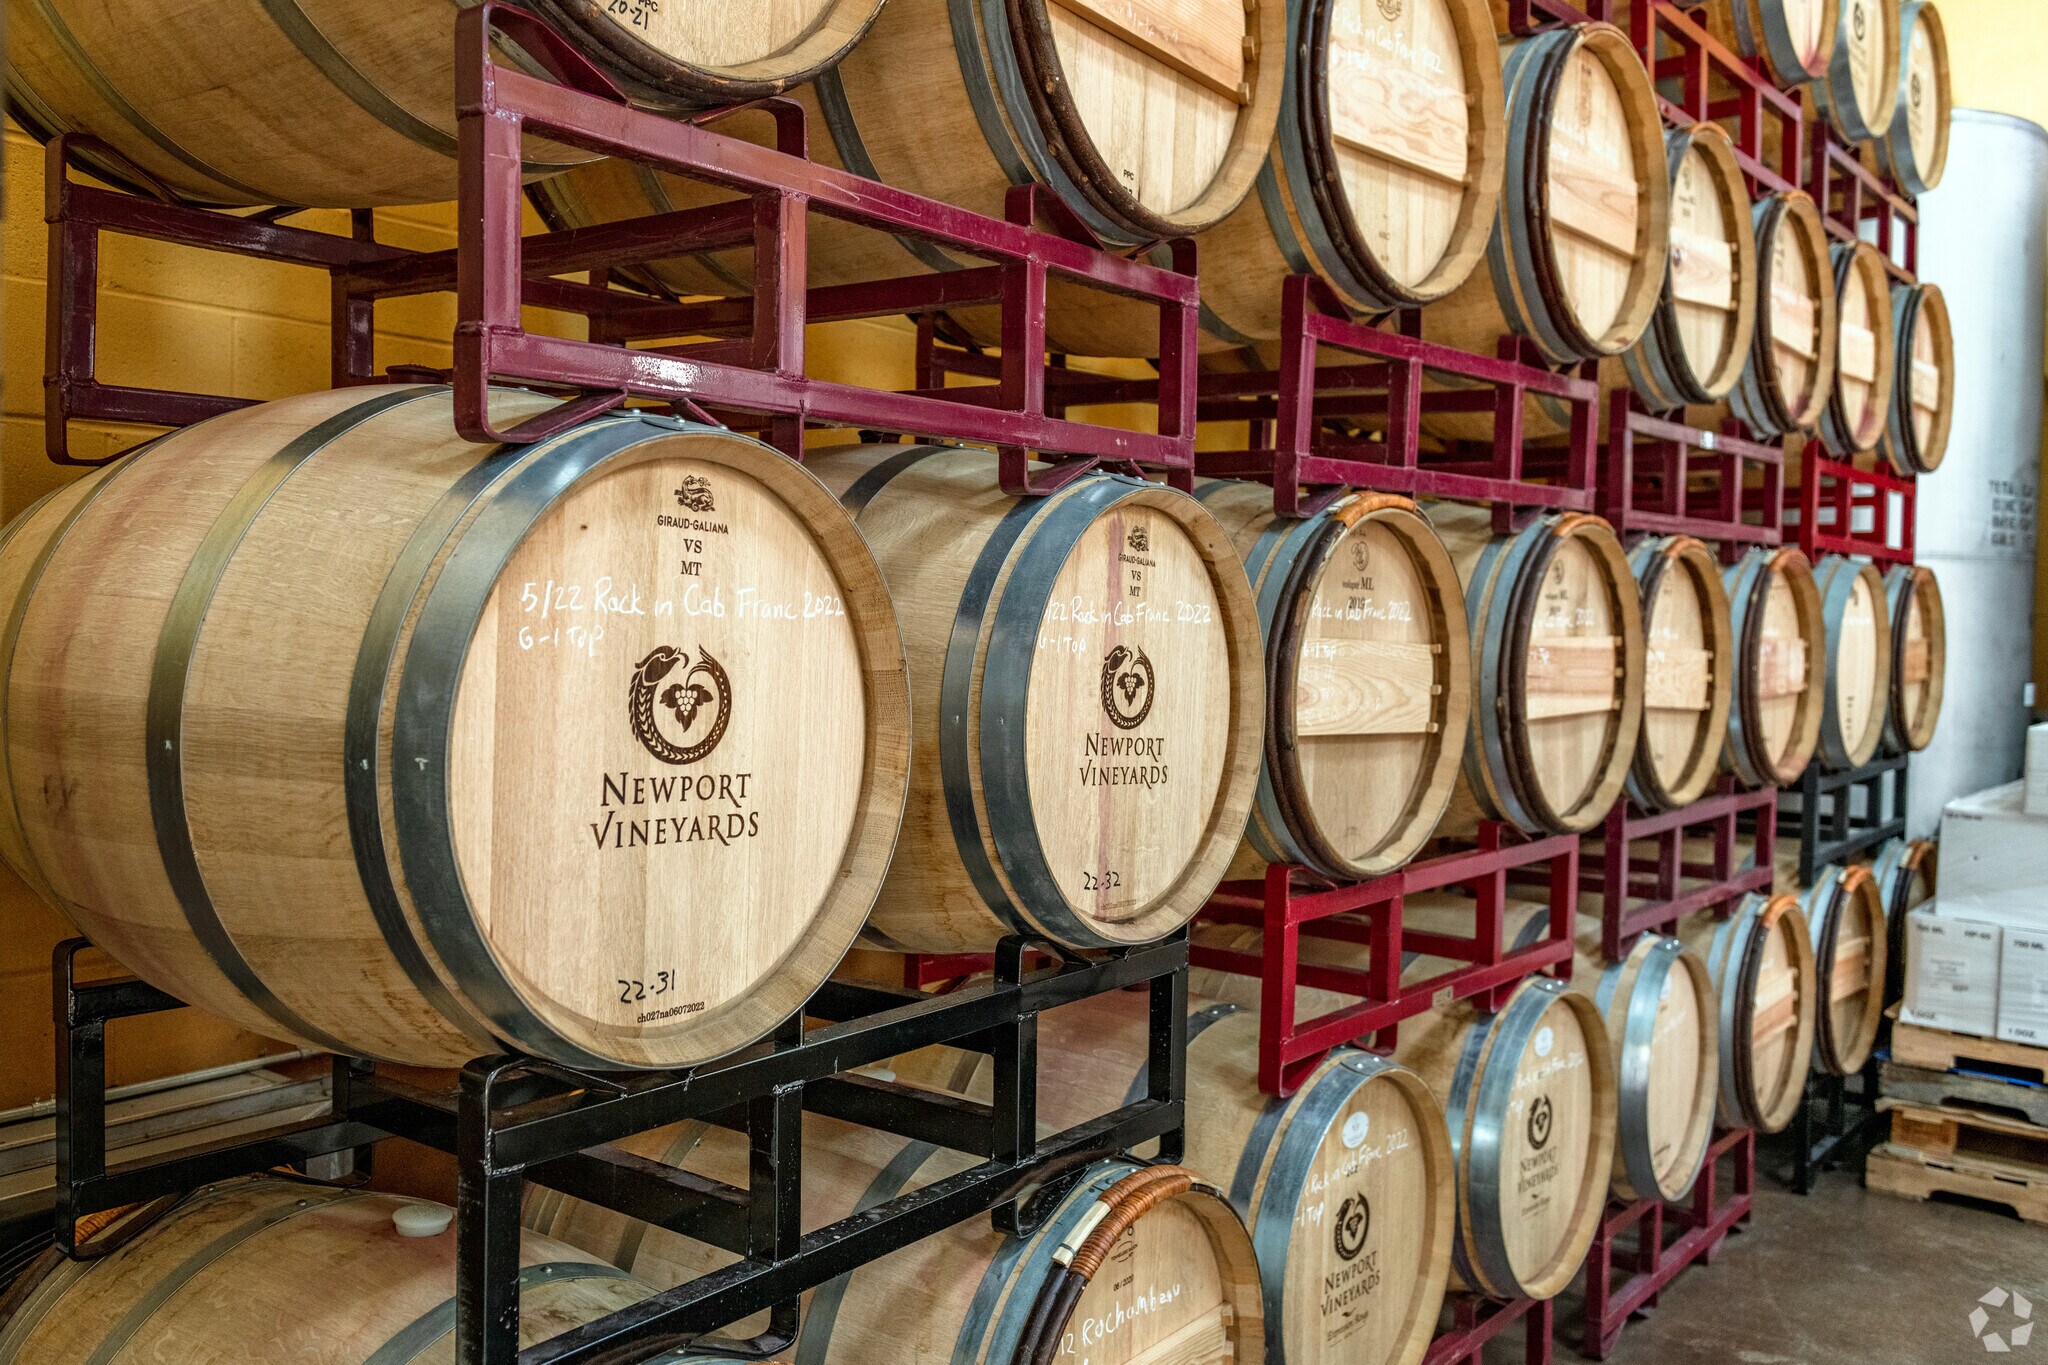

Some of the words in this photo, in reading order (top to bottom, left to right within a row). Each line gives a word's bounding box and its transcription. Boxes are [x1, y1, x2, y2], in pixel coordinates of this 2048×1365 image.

[657, 514, 729, 535] GIRAUD-GALIANA
[683, 538, 703, 554] VS
[1117, 553, 1156, 568] GIRAUD-GALIANA
[680, 560, 703, 577] MT
[1131, 570, 1142, 581] VS
[521, 579, 585, 620] 5/22
[593, 576, 646, 618] Rack
[654, 598, 674, 617] in
[684, 583, 726, 618] Cab
[736, 587, 797, 621] Franc
[803, 591, 845, 618] 2022
[1129, 585, 1141, 598] MT
[1071, 595, 1100, 625] Rack
[1113, 601, 1135, 626] Cab
[1135, 601, 1170, 625] Franc
[1176, 600, 1212, 625] 2022
[1346, 599, 1362, 621] Cab
[1084, 732, 1164, 762] NEWPORT
[600, 771, 751, 808] NEWPORT
[1079, 759, 1168, 790] VINEYARDS
[590, 810, 759, 850] VINEYARDS
[1324, 1250, 1377, 1295] NEWPORT
[1320, 1269, 1380, 1318] VINEYARDS
